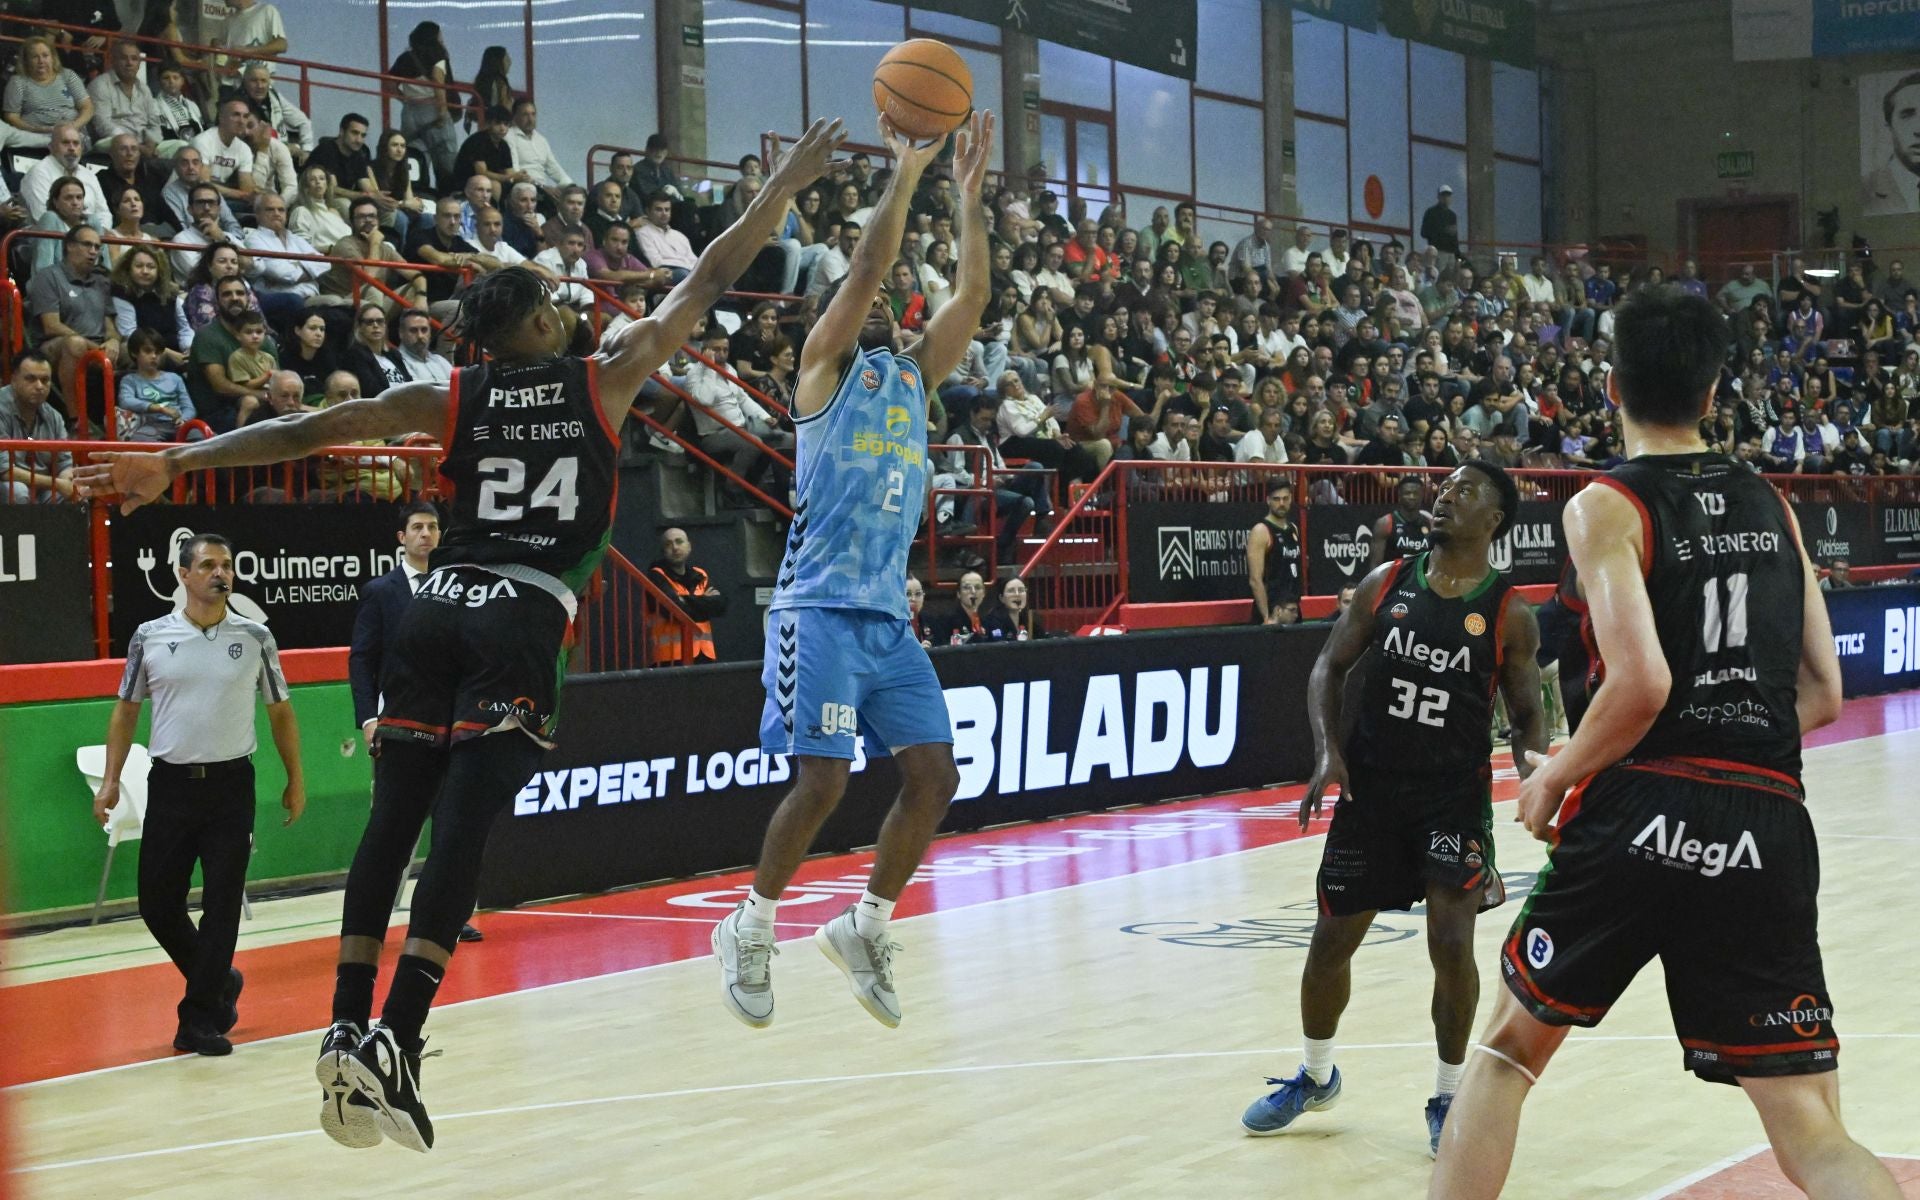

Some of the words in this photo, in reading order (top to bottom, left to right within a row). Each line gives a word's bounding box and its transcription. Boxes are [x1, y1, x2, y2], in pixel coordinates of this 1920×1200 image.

[488, 382, 565, 408] PÉREZ
[477, 456, 579, 521] 24
[882, 471, 904, 513] 2
[1694, 491, 1726, 515] YU
[1194, 530, 1226, 550] RENTAS
[1227, 530, 1235, 549] Y
[235, 550, 360, 585] Quimera
[265, 587, 287, 604] LA
[1703, 572, 1748, 653] 11
[1388, 677, 1450, 728] 32
[942, 664, 1240, 802] BILADU
[513, 756, 676, 816] EXPERT
[1530, 934, 1549, 963] B
